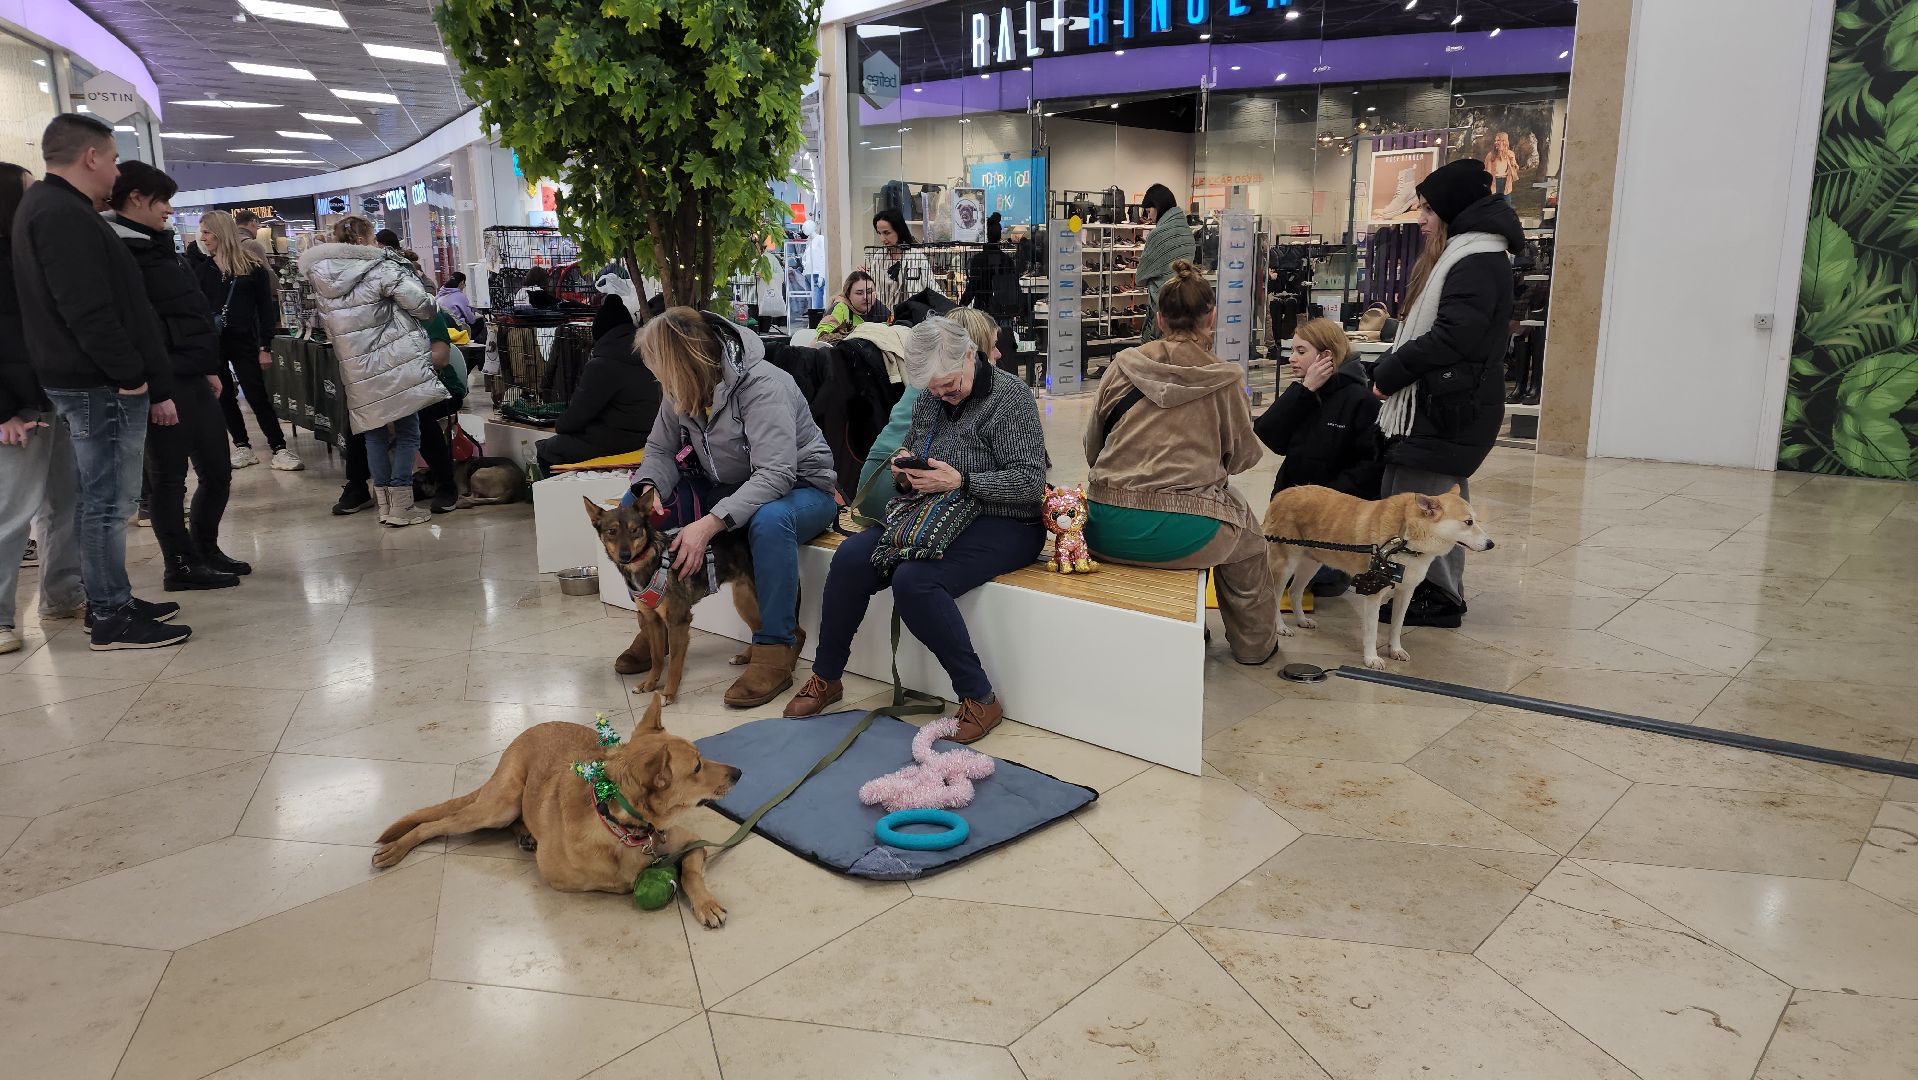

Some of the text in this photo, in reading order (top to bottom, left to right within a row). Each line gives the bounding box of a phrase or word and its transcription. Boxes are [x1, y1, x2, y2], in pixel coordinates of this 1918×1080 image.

[972, 0, 1291, 67] RALF RIN
[1058, 329, 1074, 384] RALF
